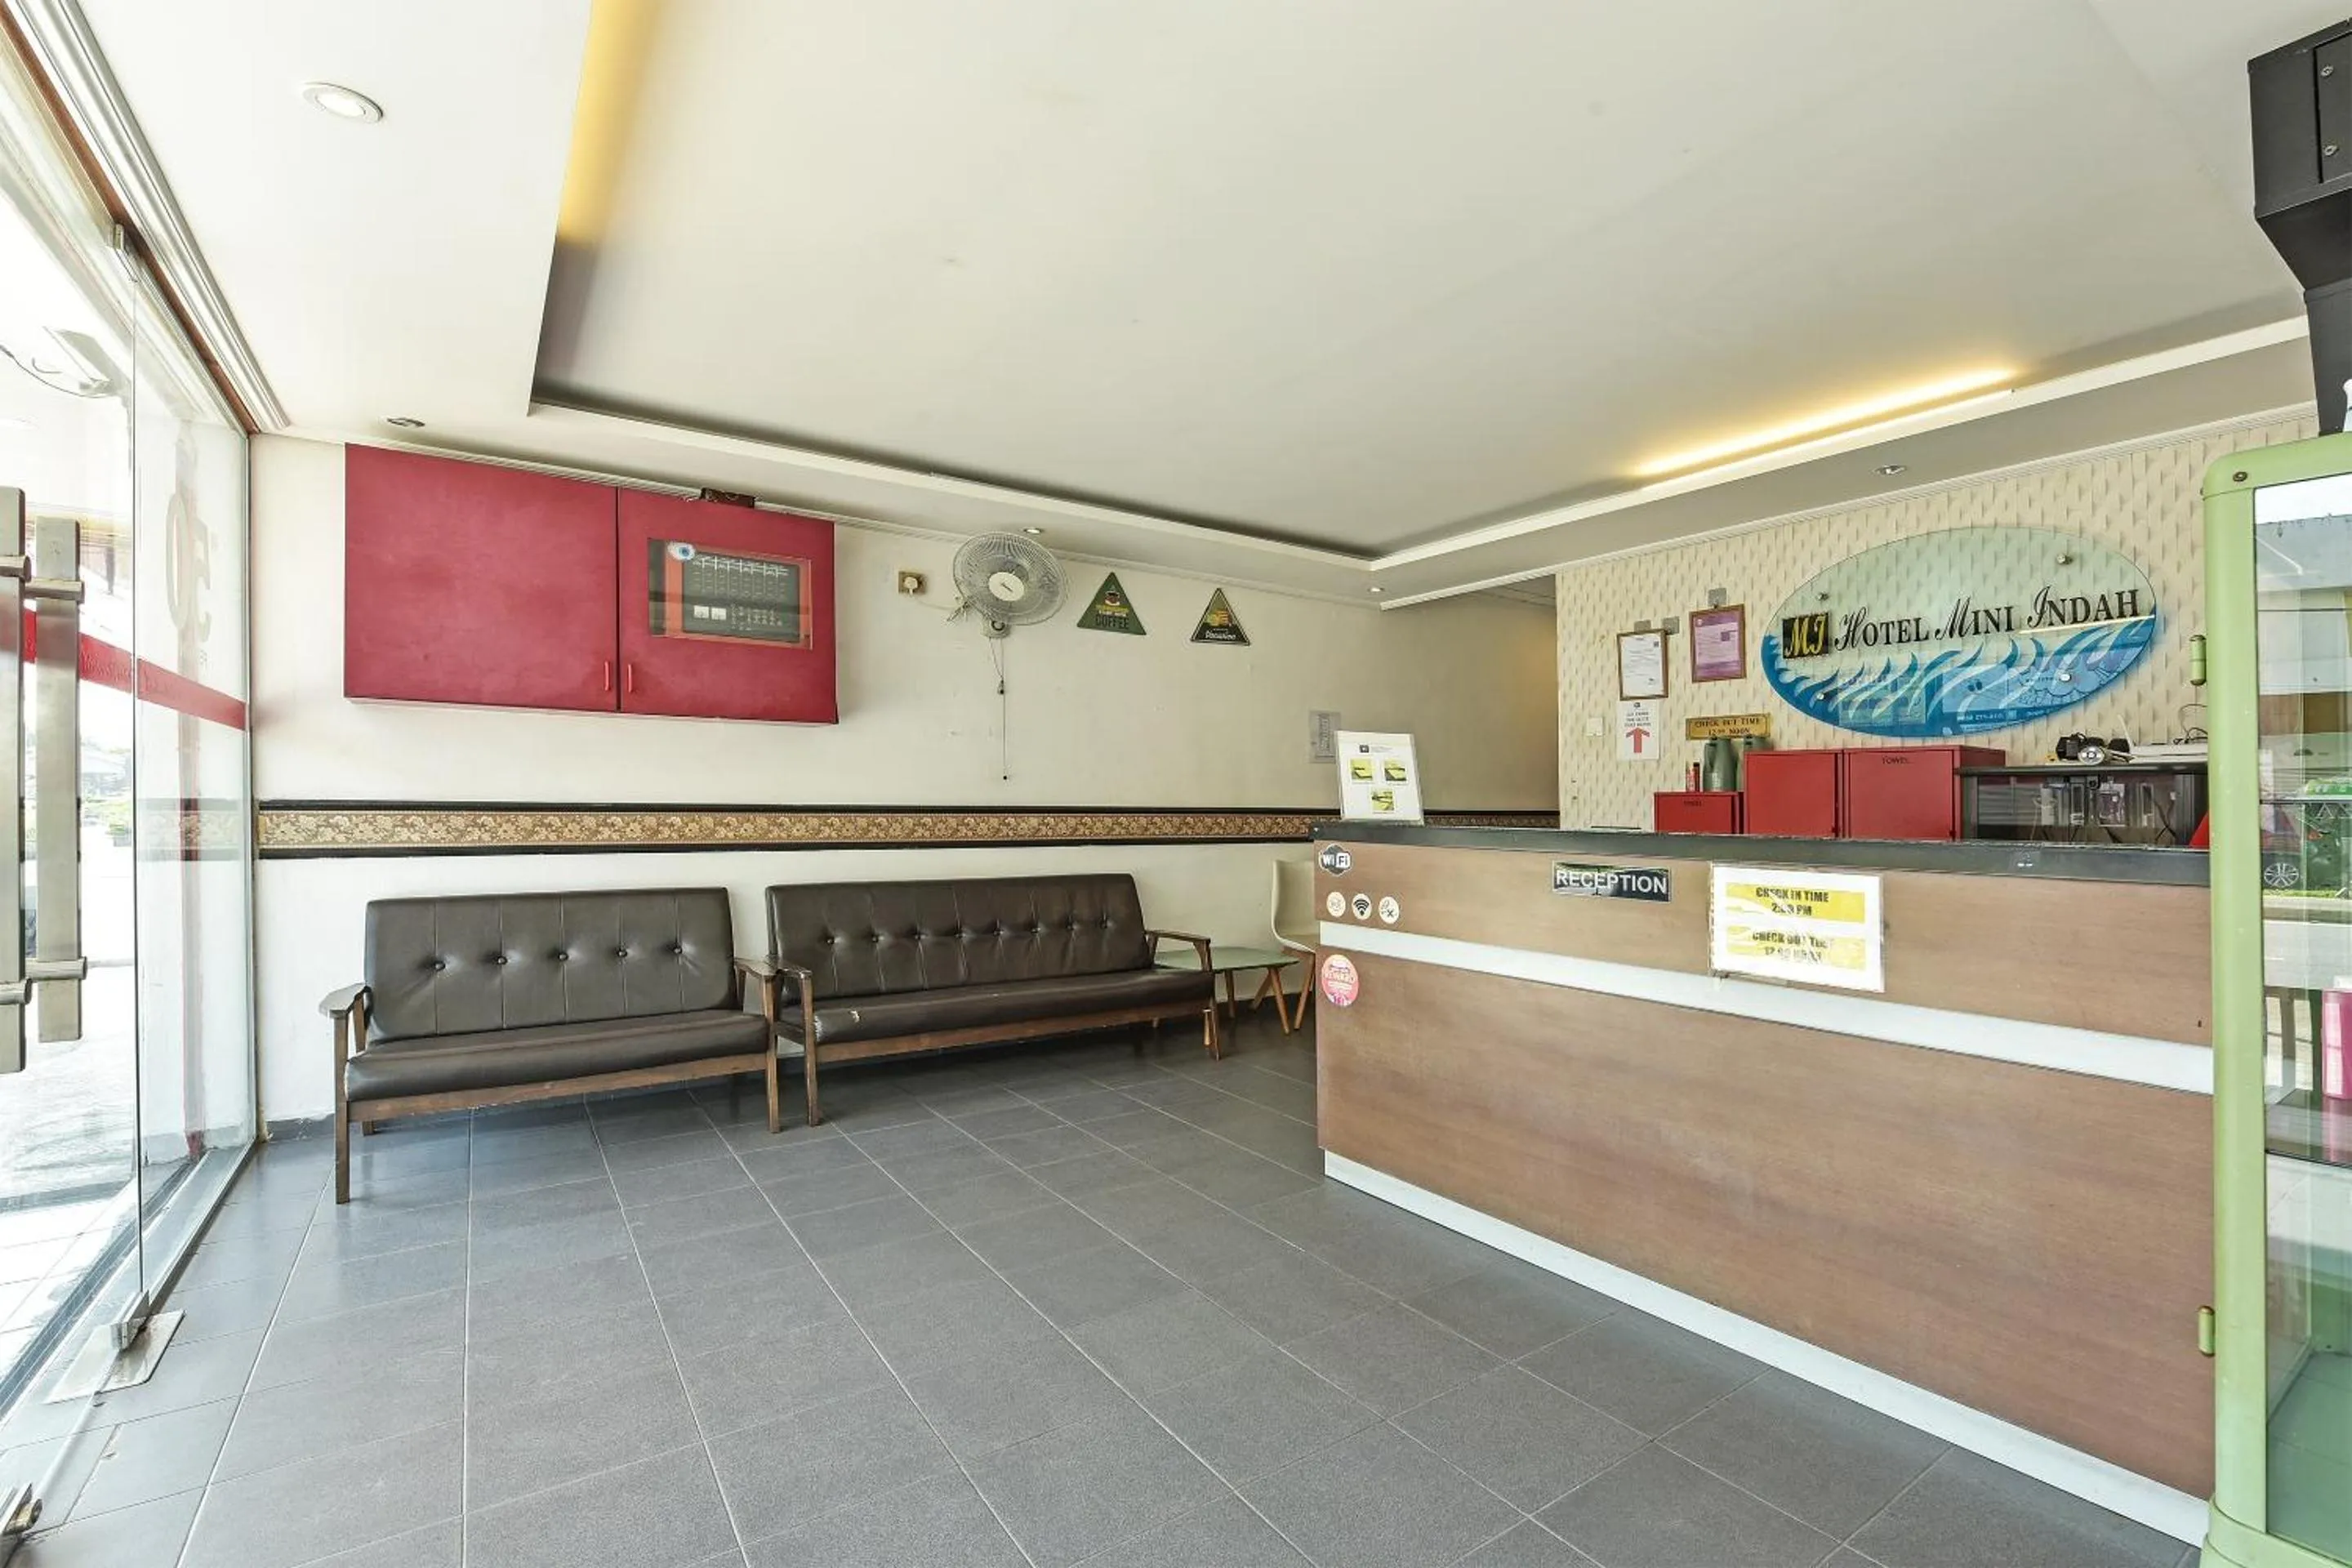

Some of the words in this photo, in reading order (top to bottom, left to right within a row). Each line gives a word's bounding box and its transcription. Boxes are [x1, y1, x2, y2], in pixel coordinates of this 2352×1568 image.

[1834, 607, 1930, 651] HOTEL
[1935, 596, 2016, 641] MINI
[2027, 585, 2139, 628] INDAH
[1556, 870, 1668, 894] RECEPTION
[1790, 889, 1802, 901] IN
[1804, 890, 1829, 902] TIME
[1797, 904, 1812, 915] PM
